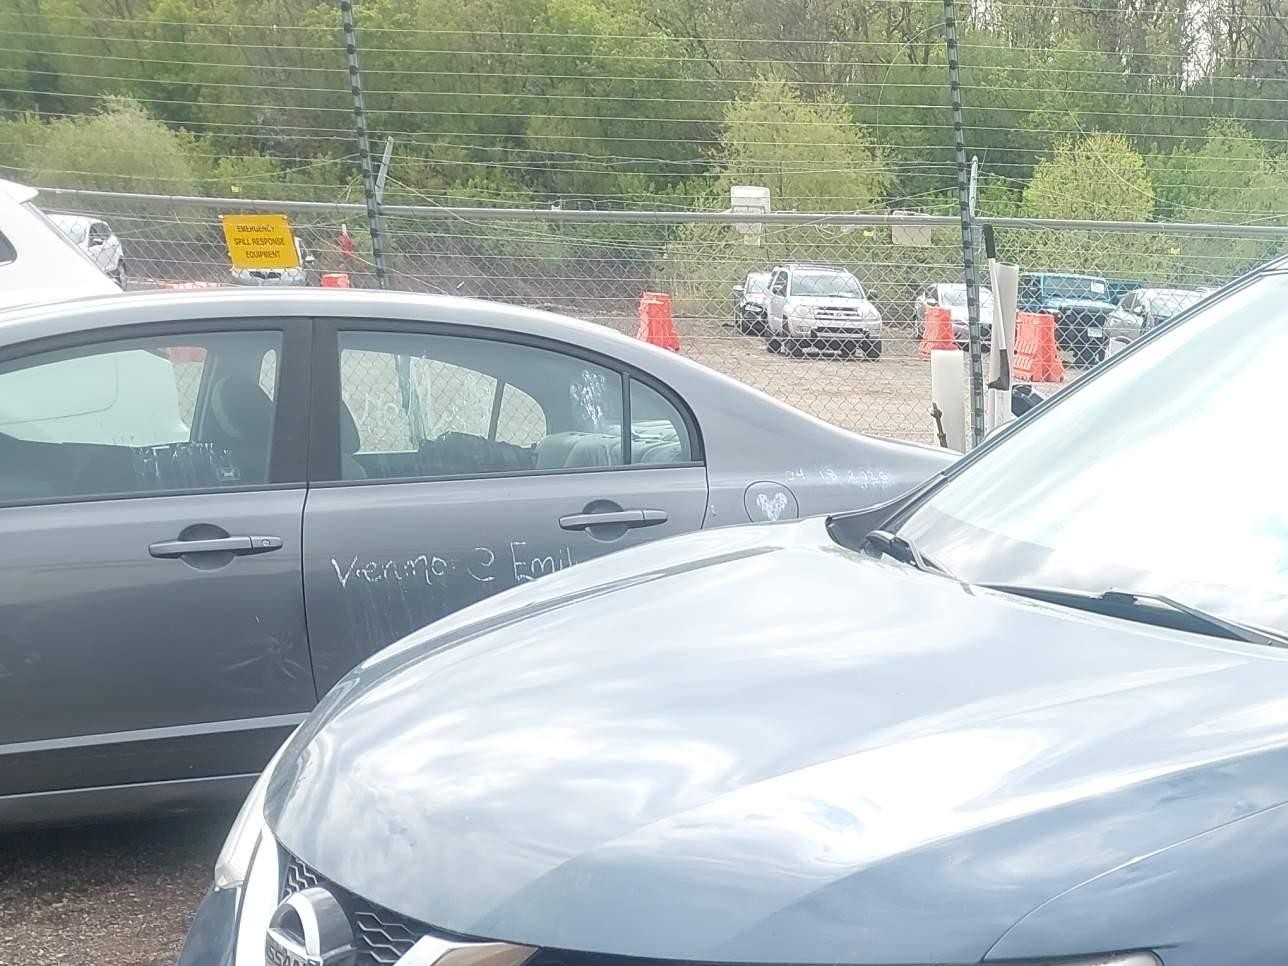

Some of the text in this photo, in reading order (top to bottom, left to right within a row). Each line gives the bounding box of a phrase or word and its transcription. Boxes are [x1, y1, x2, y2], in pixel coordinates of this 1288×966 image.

[236, 225, 275, 233] EMERGENCY
[233, 238, 286, 246] SPILL RESPONSE
[245, 250, 281, 259] EQUIPMENT
